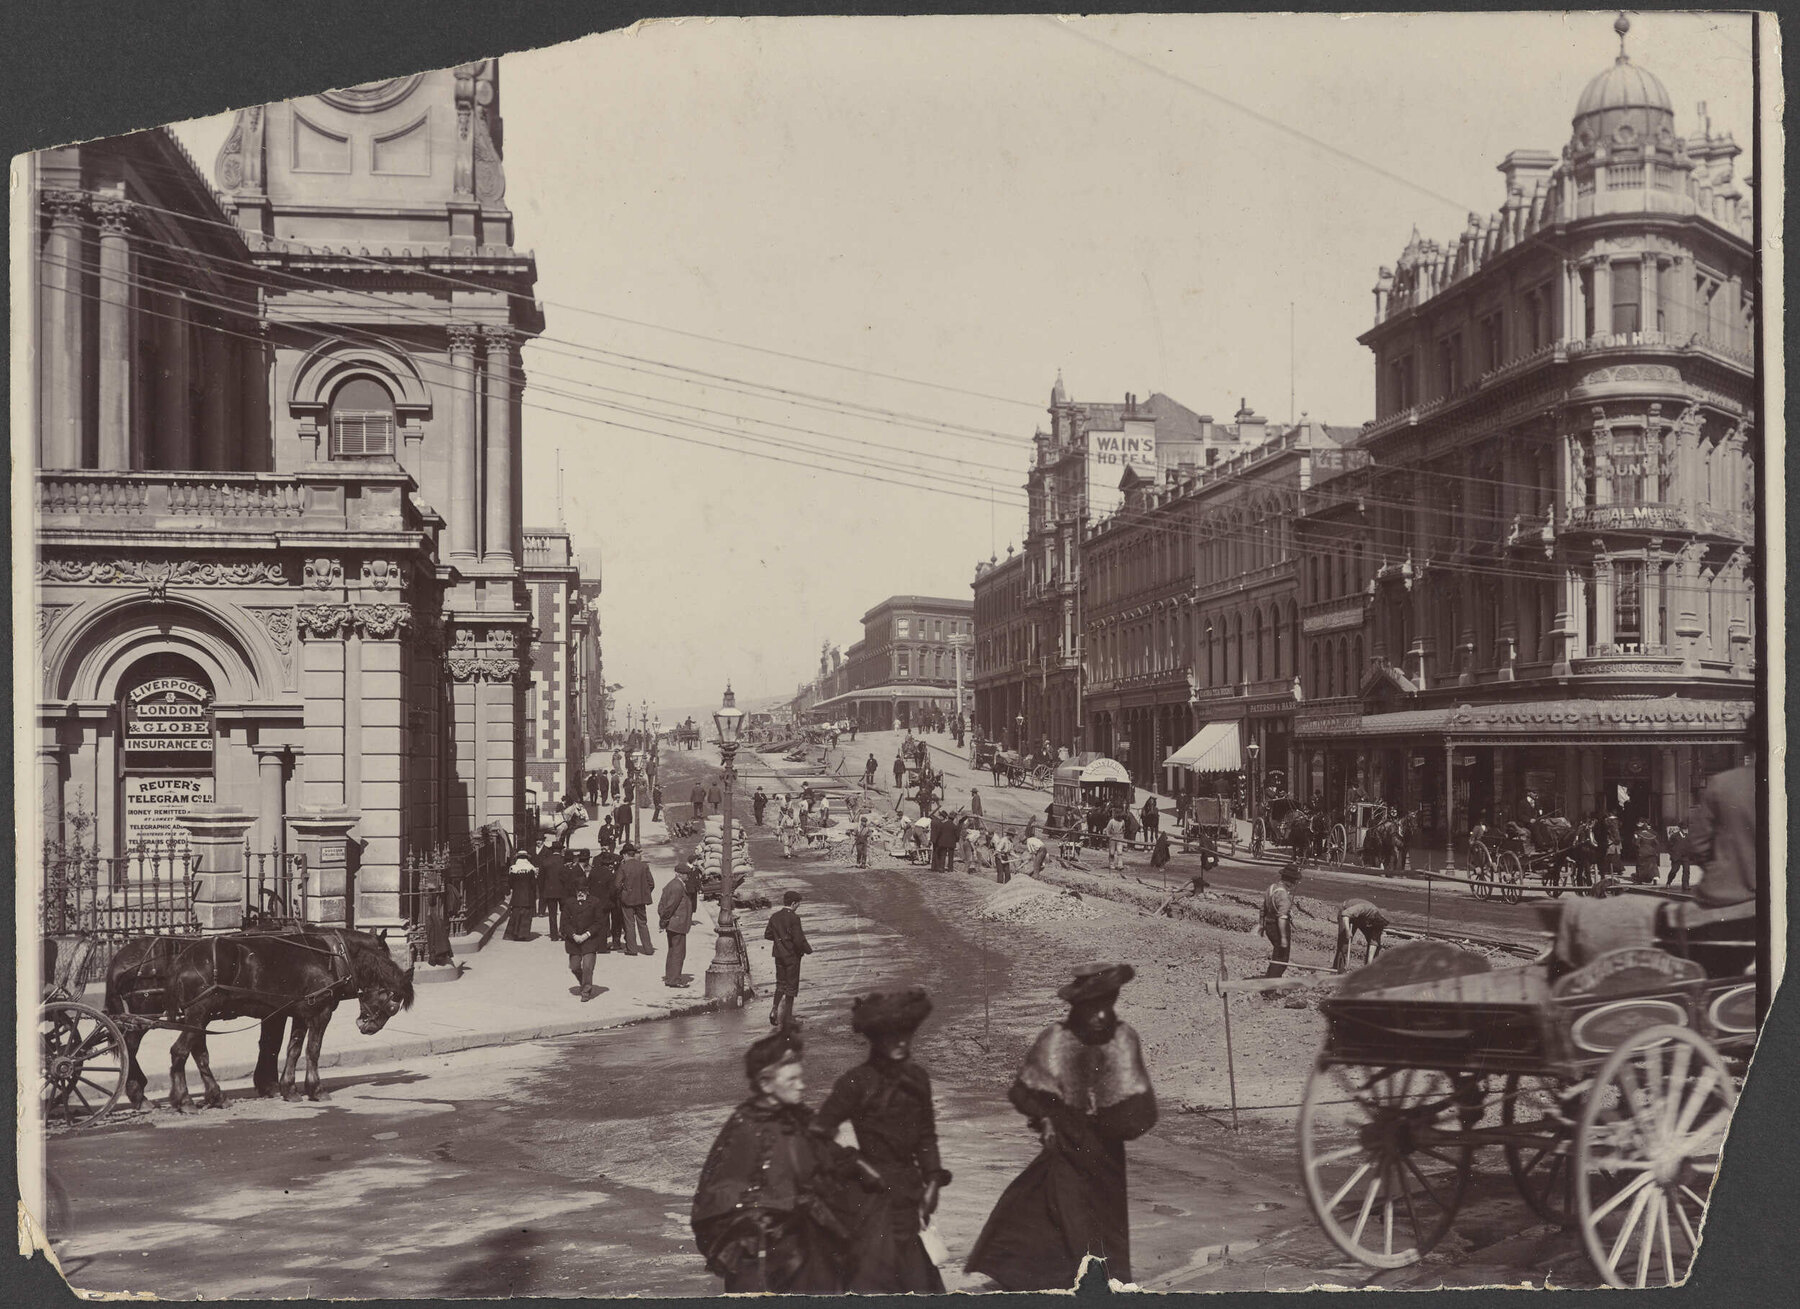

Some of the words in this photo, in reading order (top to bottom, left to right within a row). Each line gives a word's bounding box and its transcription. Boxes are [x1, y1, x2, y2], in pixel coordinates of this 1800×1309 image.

[1097, 437, 1153, 452] WAIN'S
[1098, 453, 1152, 465] HOTEL
[132, 680, 203, 698] LIVERPOOL
[167, 693, 173, 701] &
[140, 706, 198, 715] LONDON
[130, 724, 140, 732] &
[143, 723, 206, 732] GLOBE
[128, 740, 198, 749] INSURANCE
[139, 780, 201, 792] REUTER'S
[128, 795, 189, 803] TELEGRAM
